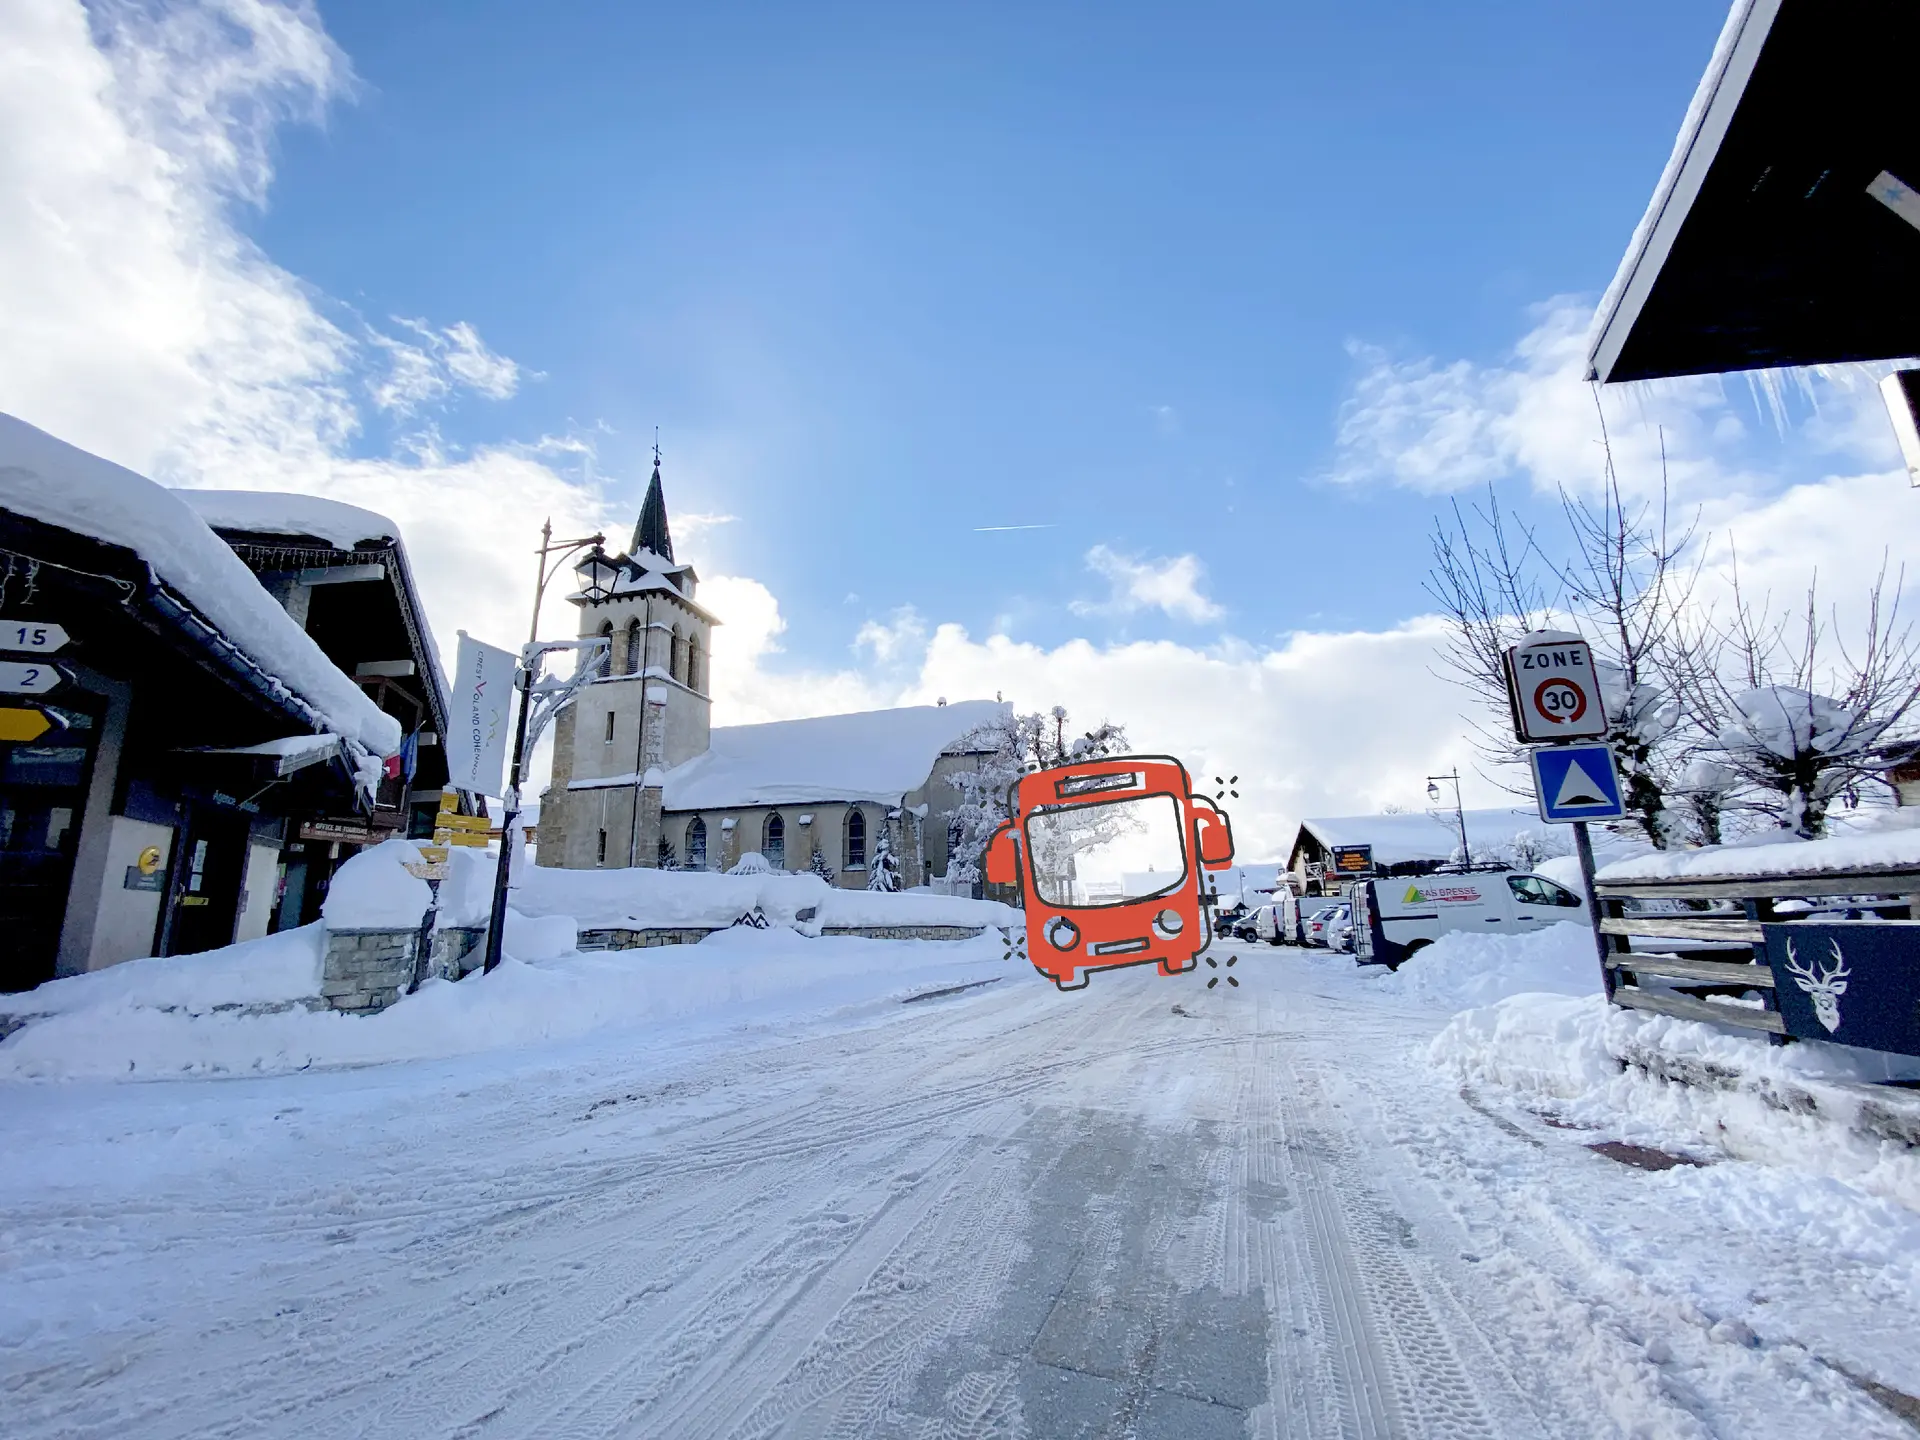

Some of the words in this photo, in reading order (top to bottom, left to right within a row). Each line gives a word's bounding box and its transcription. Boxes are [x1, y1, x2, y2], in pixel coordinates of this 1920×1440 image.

[17, 628, 47, 645] 15
[475, 651, 484, 680] CREST
[1521, 650, 1583, 670] ZONE
[20, 669, 39, 686] 2
[472, 681, 487, 726] VOLAND
[1545, 691, 1576, 710] 30
[315, 823, 334, 831] OFFICE
[343, 826, 368, 835] TOURISME
[1419, 889, 1437, 897] SAS
[1439, 887, 1477, 897] BRESSE
